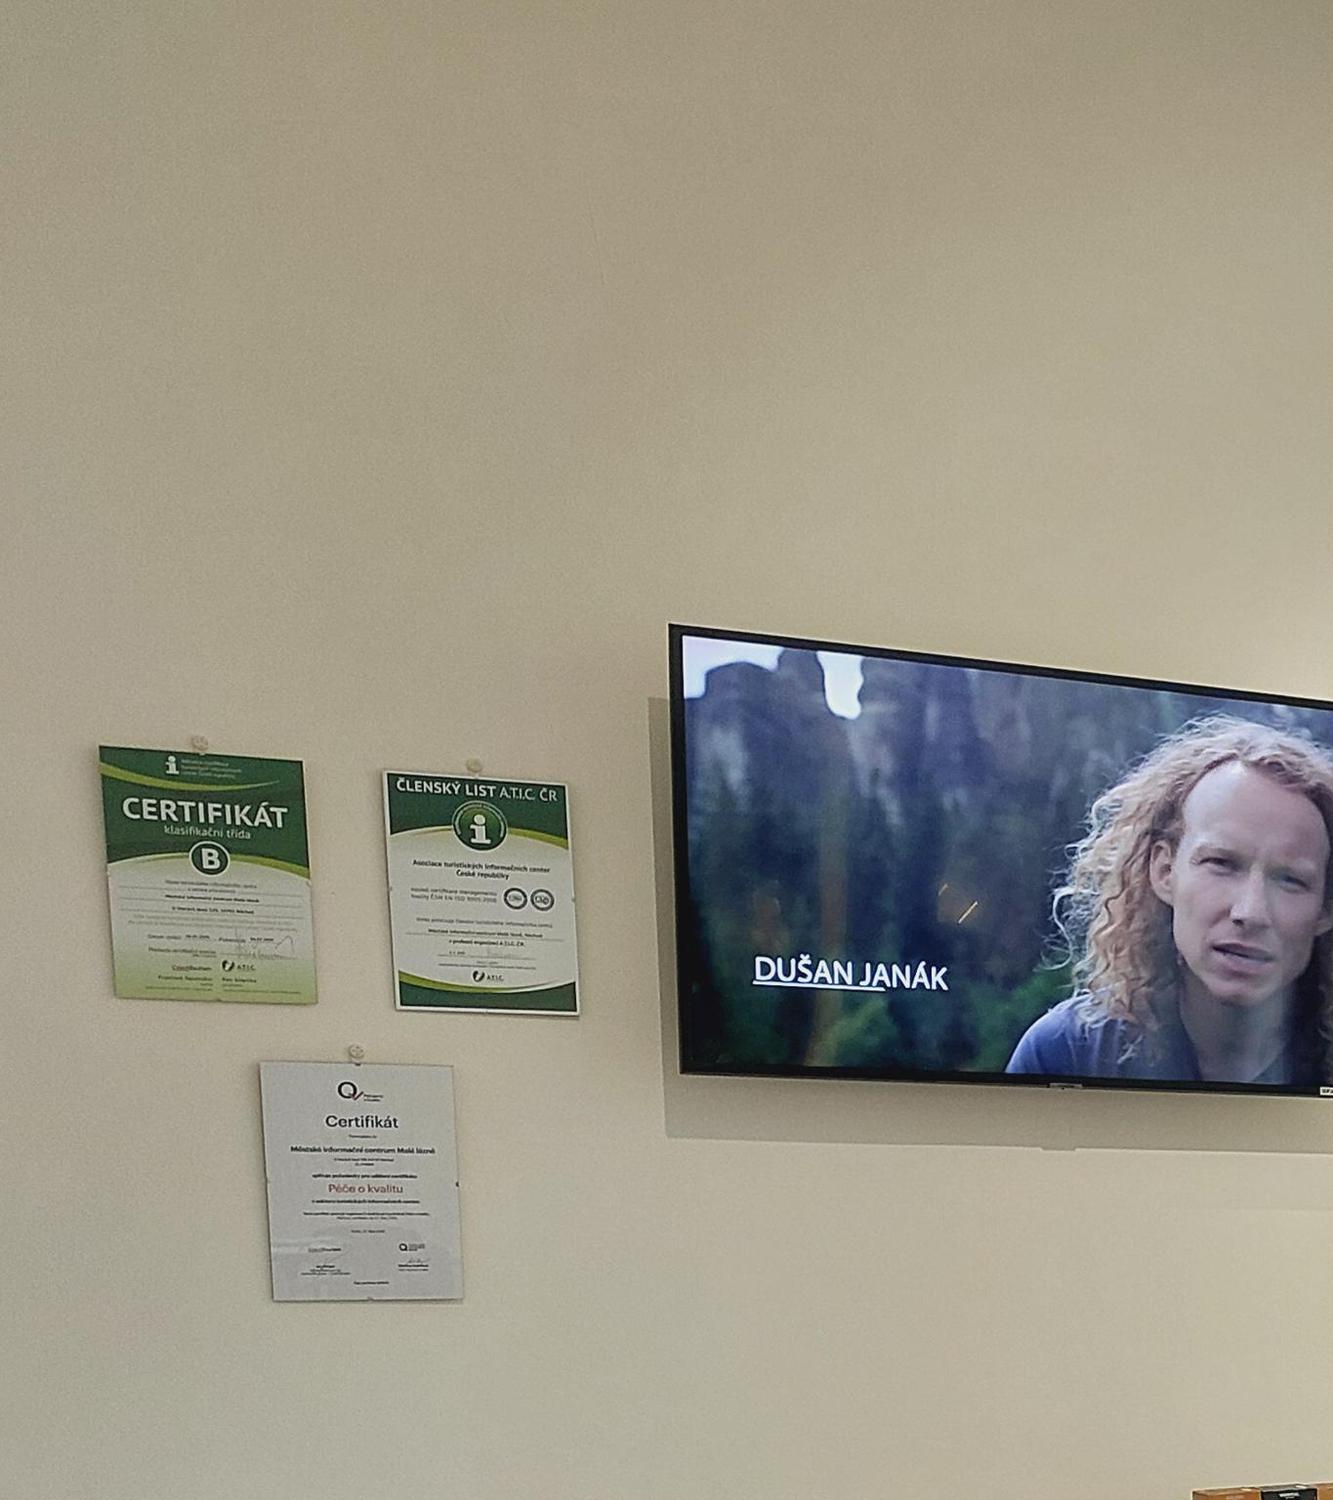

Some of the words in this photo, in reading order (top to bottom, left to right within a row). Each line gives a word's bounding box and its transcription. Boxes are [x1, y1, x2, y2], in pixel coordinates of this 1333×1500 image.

[396, 777, 461, 794] ČLENSKÝ
[465, 787, 496, 798] LIST
[539, 786, 557, 802] ČR
[122, 797, 289, 828] CERTIFIKÁT
[164, 825, 224, 838] klasifikační
[226, 829, 251, 839] třída
[201, 847, 221, 869] B
[753, 953, 853, 985] DUŠAN
[859, 960, 950, 991] JANÁK
[325, 1114, 399, 1129] Certifikát
[328, 1183, 356, 1195] Péče
[357, 1186, 366, 1194] o
[367, 1184, 404, 1195] kvalitu
